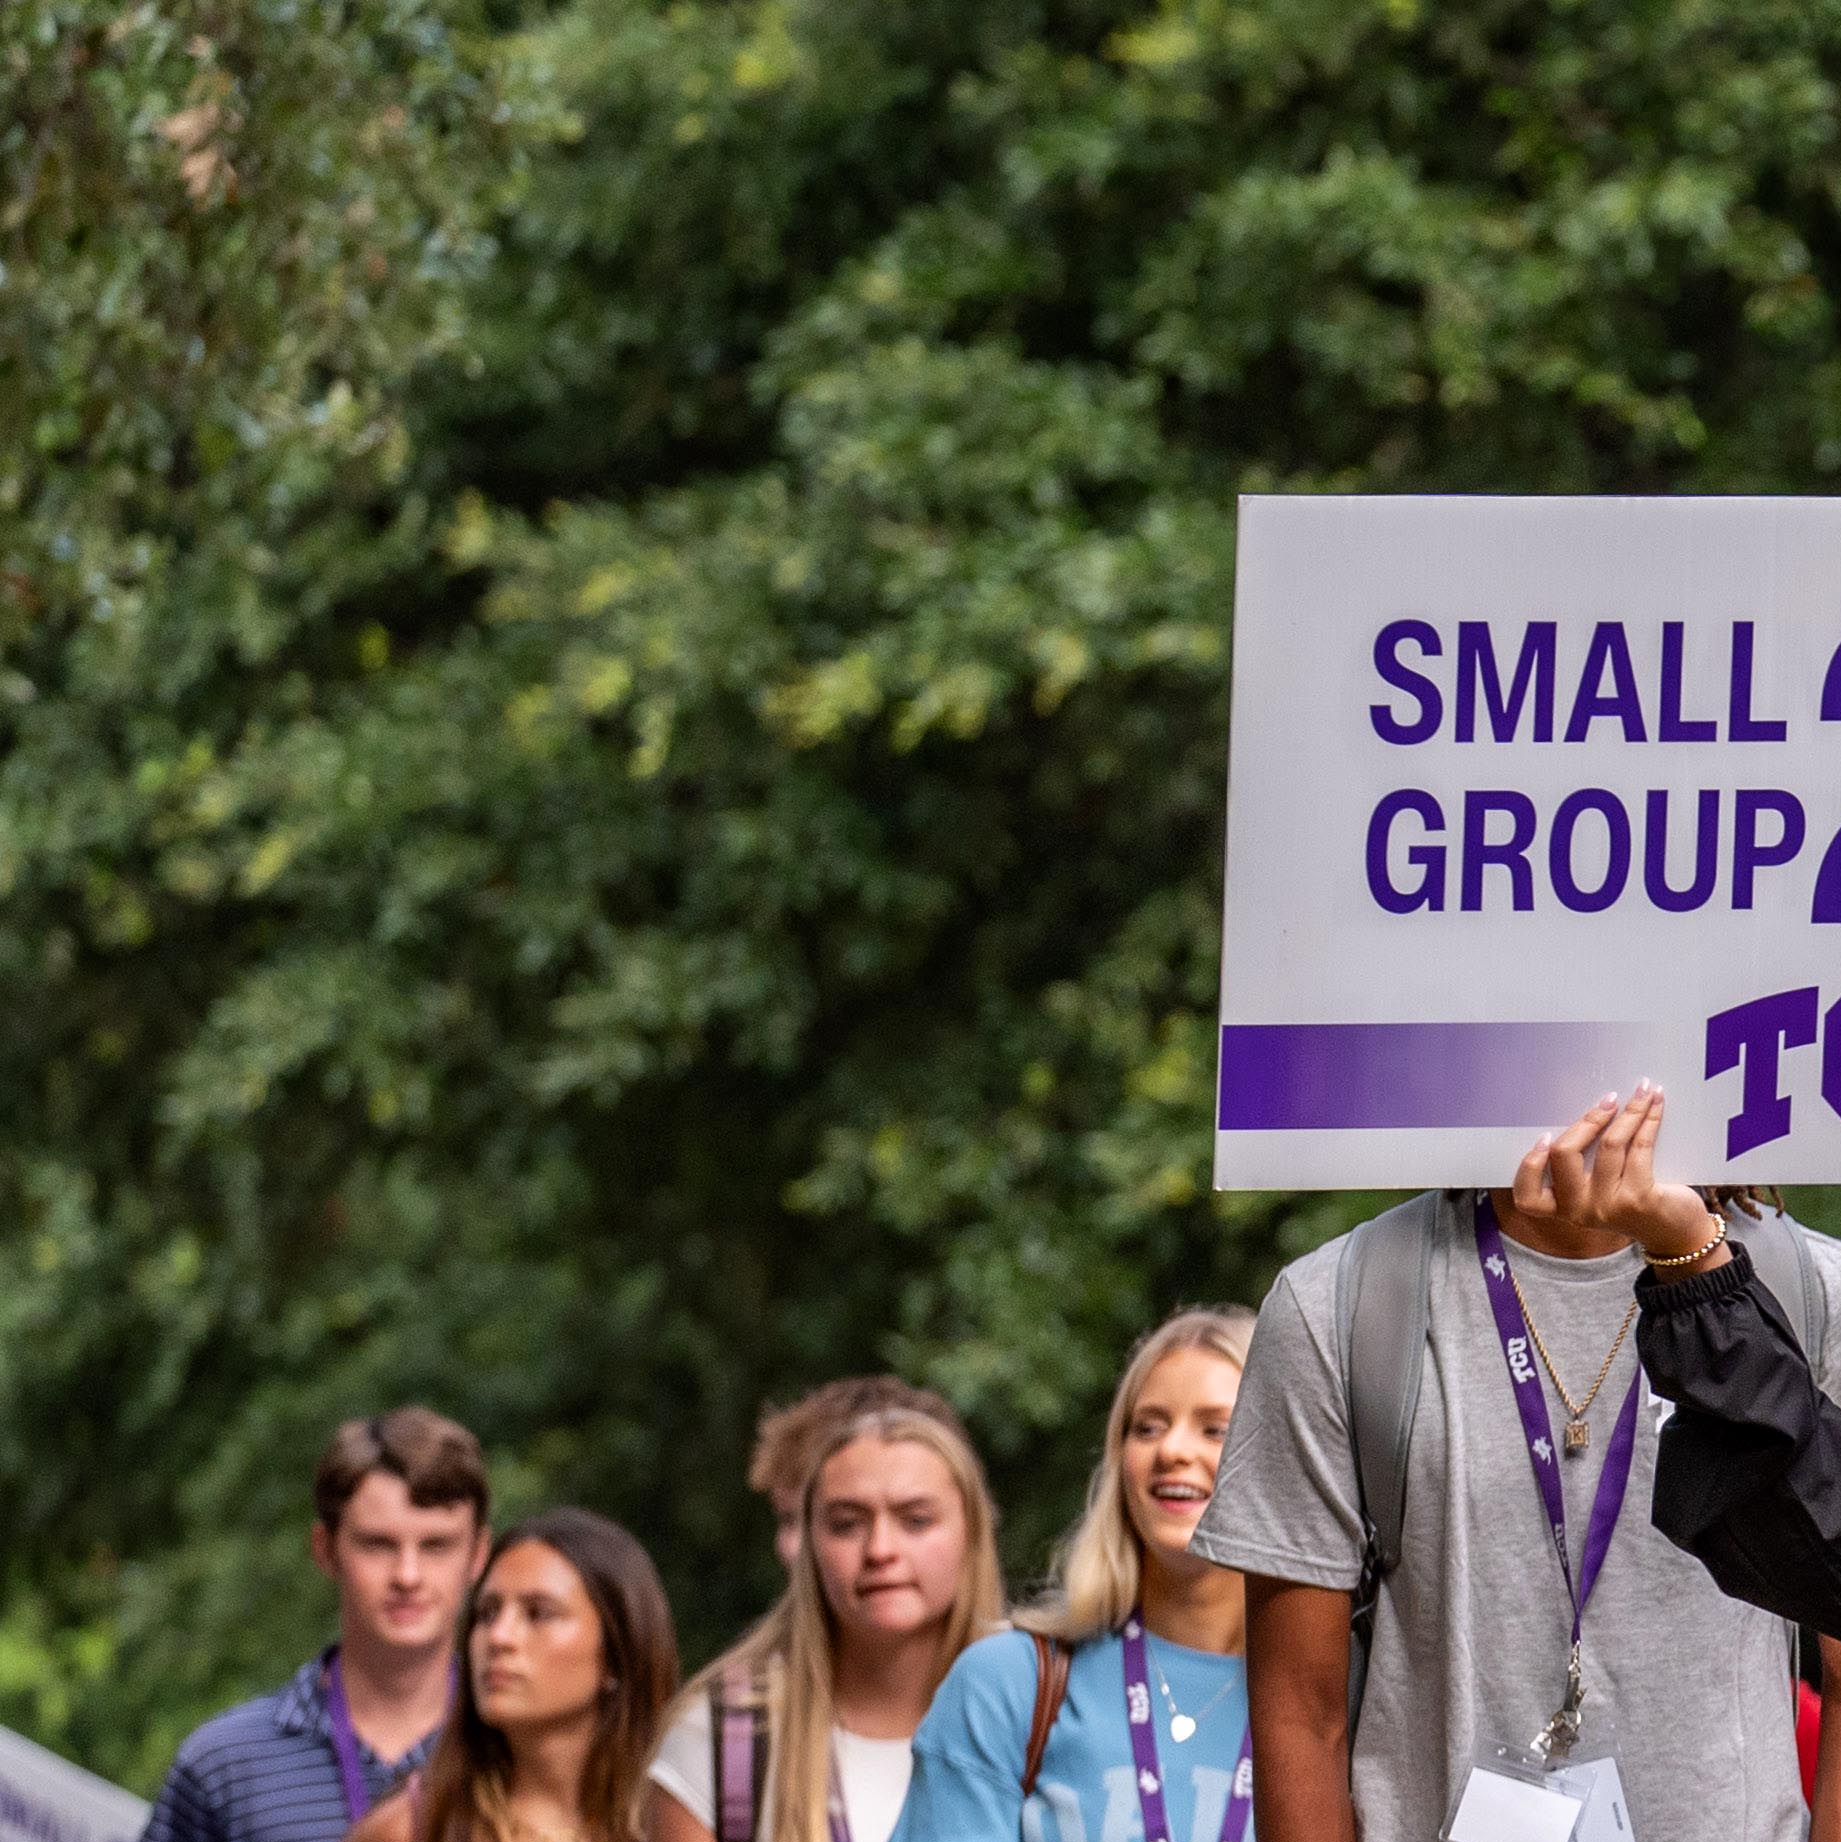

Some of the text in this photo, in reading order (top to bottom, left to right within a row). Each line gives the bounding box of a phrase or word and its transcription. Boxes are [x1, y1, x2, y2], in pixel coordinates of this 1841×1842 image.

[1368, 618, 1788, 746] SMALL
[1364, 787, 1806, 914] GROUP
[1507, 1336, 1536, 1384] TCU
